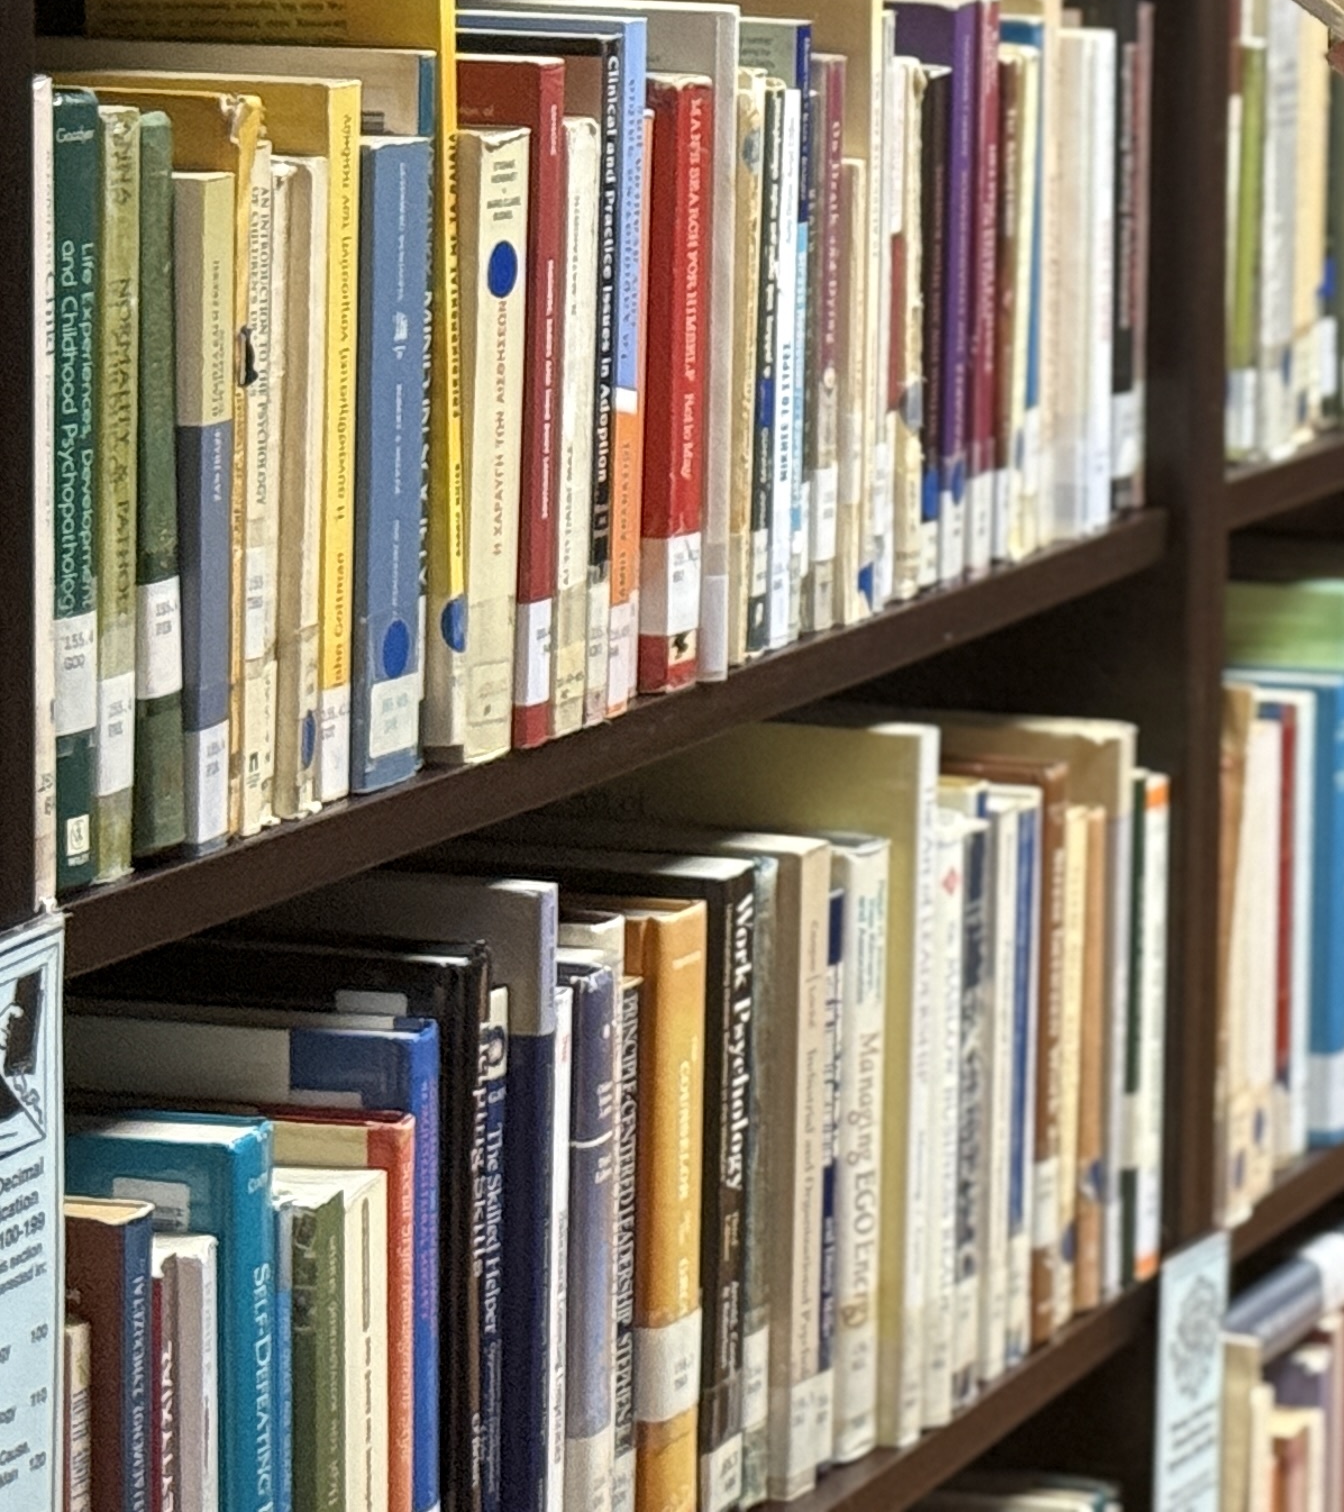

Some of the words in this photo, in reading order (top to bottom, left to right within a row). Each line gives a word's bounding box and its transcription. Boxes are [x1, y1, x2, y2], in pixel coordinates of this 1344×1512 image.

[607, 55, 621, 136] Clinical
[258, 186, 271, 210] AN
[605, 141, 617, 184] and
[603, 189, 616, 280] Practice
[686, 166, 700, 248] SEARCH
[61, 240, 77, 287] and
[80, 242, 95, 285] Life
[257, 213, 271, 337] INTRODUCTION
[61, 296, 78, 415] Childhood
[257, 341, 270, 365] TO
[602, 285, 614, 353] Issues
[78, 290, 95, 441] Experiences,
[257, 368, 270, 400] THE
[601, 357, 612, 378] in
[254, 403, 269, 506] PSYCHOLOGY
[597, 383, 611, 484] Adoption
[733, 892, 756, 990] Work
[619, 993, 639, 1207] PRINCIPLE-CENTERED
[726, 996, 751, 1190] Psychology
[845, 1032, 880, 1167] Managing
[485, 1126, 503, 1169] The
[485, 1174, 503, 1254] Skilled
[853, 1169, 877, 1236] EGO
[482, 1256, 501, 1334] Helper
[616, 1208, 636, 1325] LEADERSHIP
[252, 1262, 273, 1497] SELF-DEFEATING
[615, 1332, 634, 1421] STEPHEN
